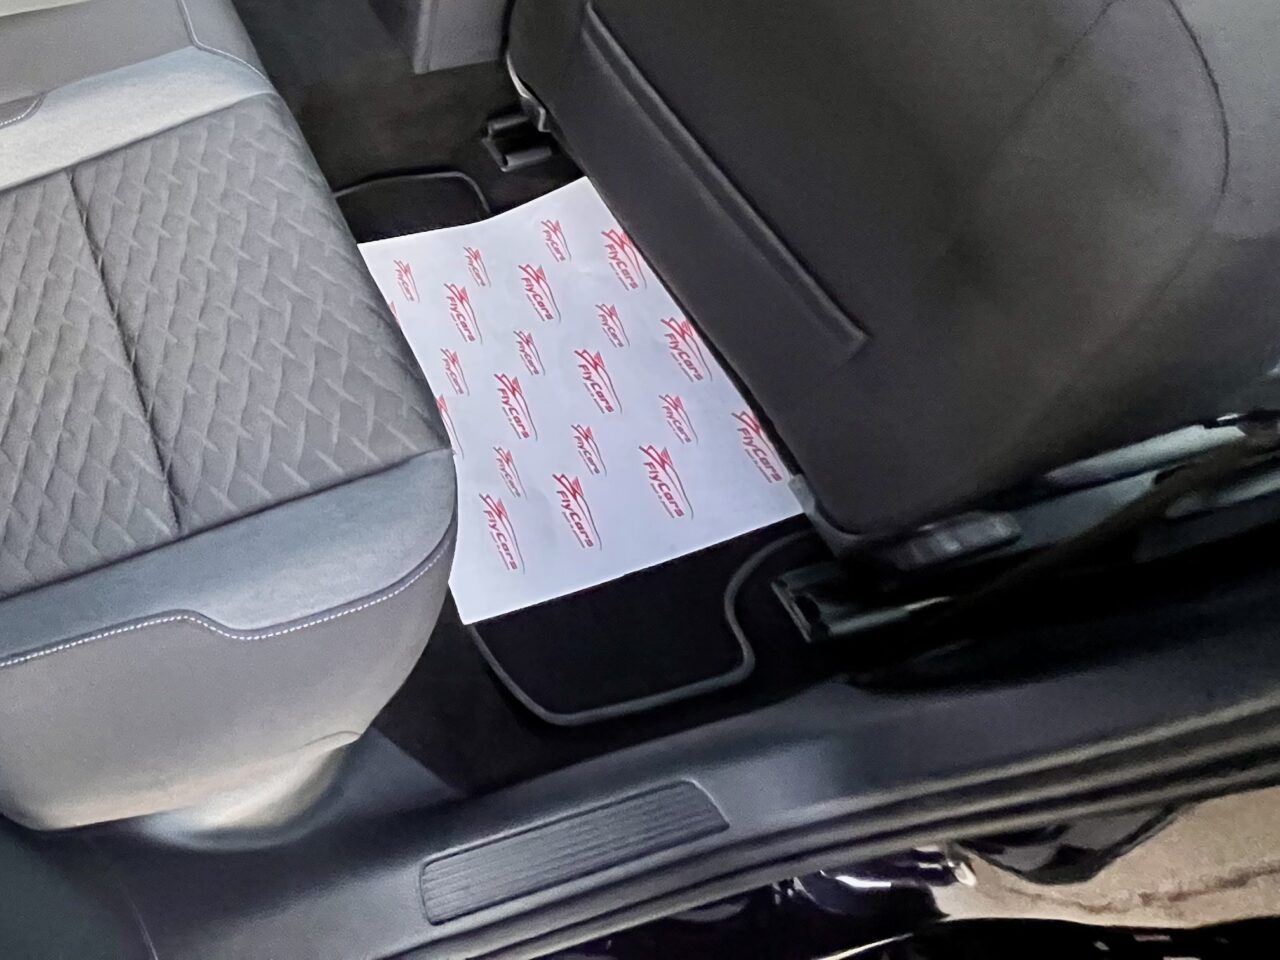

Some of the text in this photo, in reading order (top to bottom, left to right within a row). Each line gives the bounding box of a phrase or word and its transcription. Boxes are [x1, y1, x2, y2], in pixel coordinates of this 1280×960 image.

[605, 243, 638, 289] FlyCars
[447, 296, 475, 342] FlyCars
[521, 277, 553, 320] FlyCars
[598, 314, 624, 347] FlyCars
[664, 333, 704, 381] FlyCars
[578, 364, 614, 413] FlyCars
[497, 388, 530, 439] FlyCars
[662, 406, 692, 443] FlyCars
[573, 435, 600, 474] FlyCars
[737, 427, 782, 482] FlyCars
[643, 461, 684, 518] FlyCars
[483, 510, 517, 570] FlyCars
[556, 490, 594, 547] FlyCars
